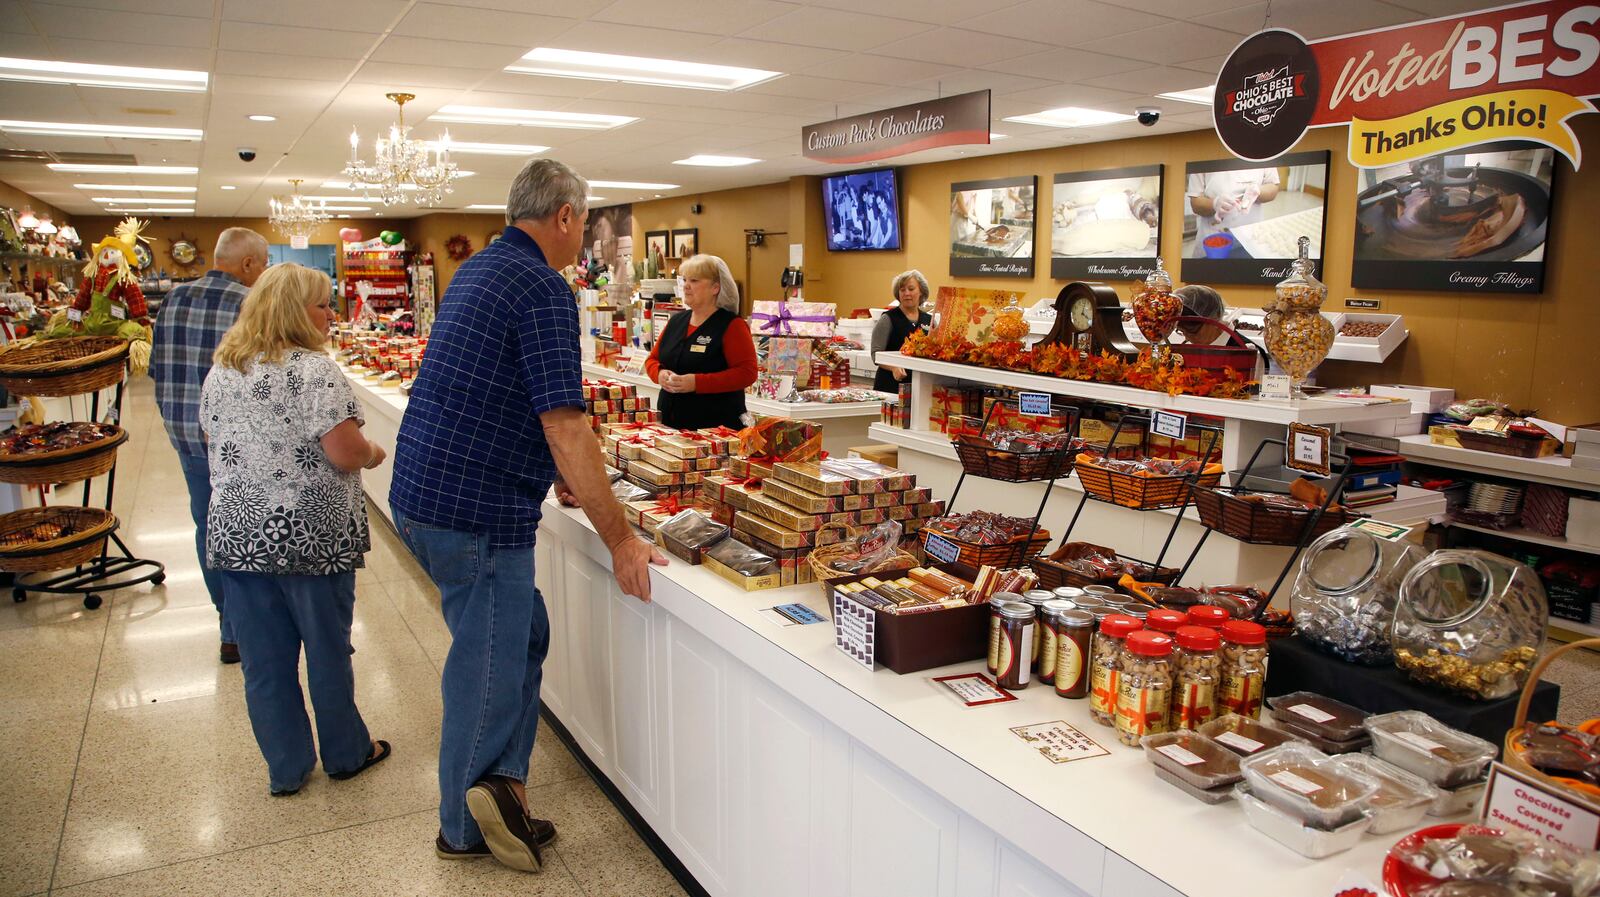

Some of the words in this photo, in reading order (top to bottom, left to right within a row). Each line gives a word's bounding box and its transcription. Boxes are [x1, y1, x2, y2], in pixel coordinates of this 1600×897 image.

[1329, 21, 1466, 110] Voted
[1233, 86, 1294, 112] CHOCOLATE
[1236, 84, 1268, 100] OHIO'S
[1269, 76, 1294, 91] BEST
[808, 131, 847, 151] Custom
[849, 122, 876, 144] Pack
[878, 110, 945, 139] Chocolates
[1361, 116, 1456, 154] Thanks
[1462, 100, 1547, 131] Ohio!
[1260, 267, 1285, 278] Hand
[1449, 271, 1488, 288] Creamy
[1491, 272, 1534, 288] Fillings
[1514, 788, 1571, 819] Chocolate
[1492, 809, 1542, 836] Sandwich
[1517, 805, 1564, 831] Covered
